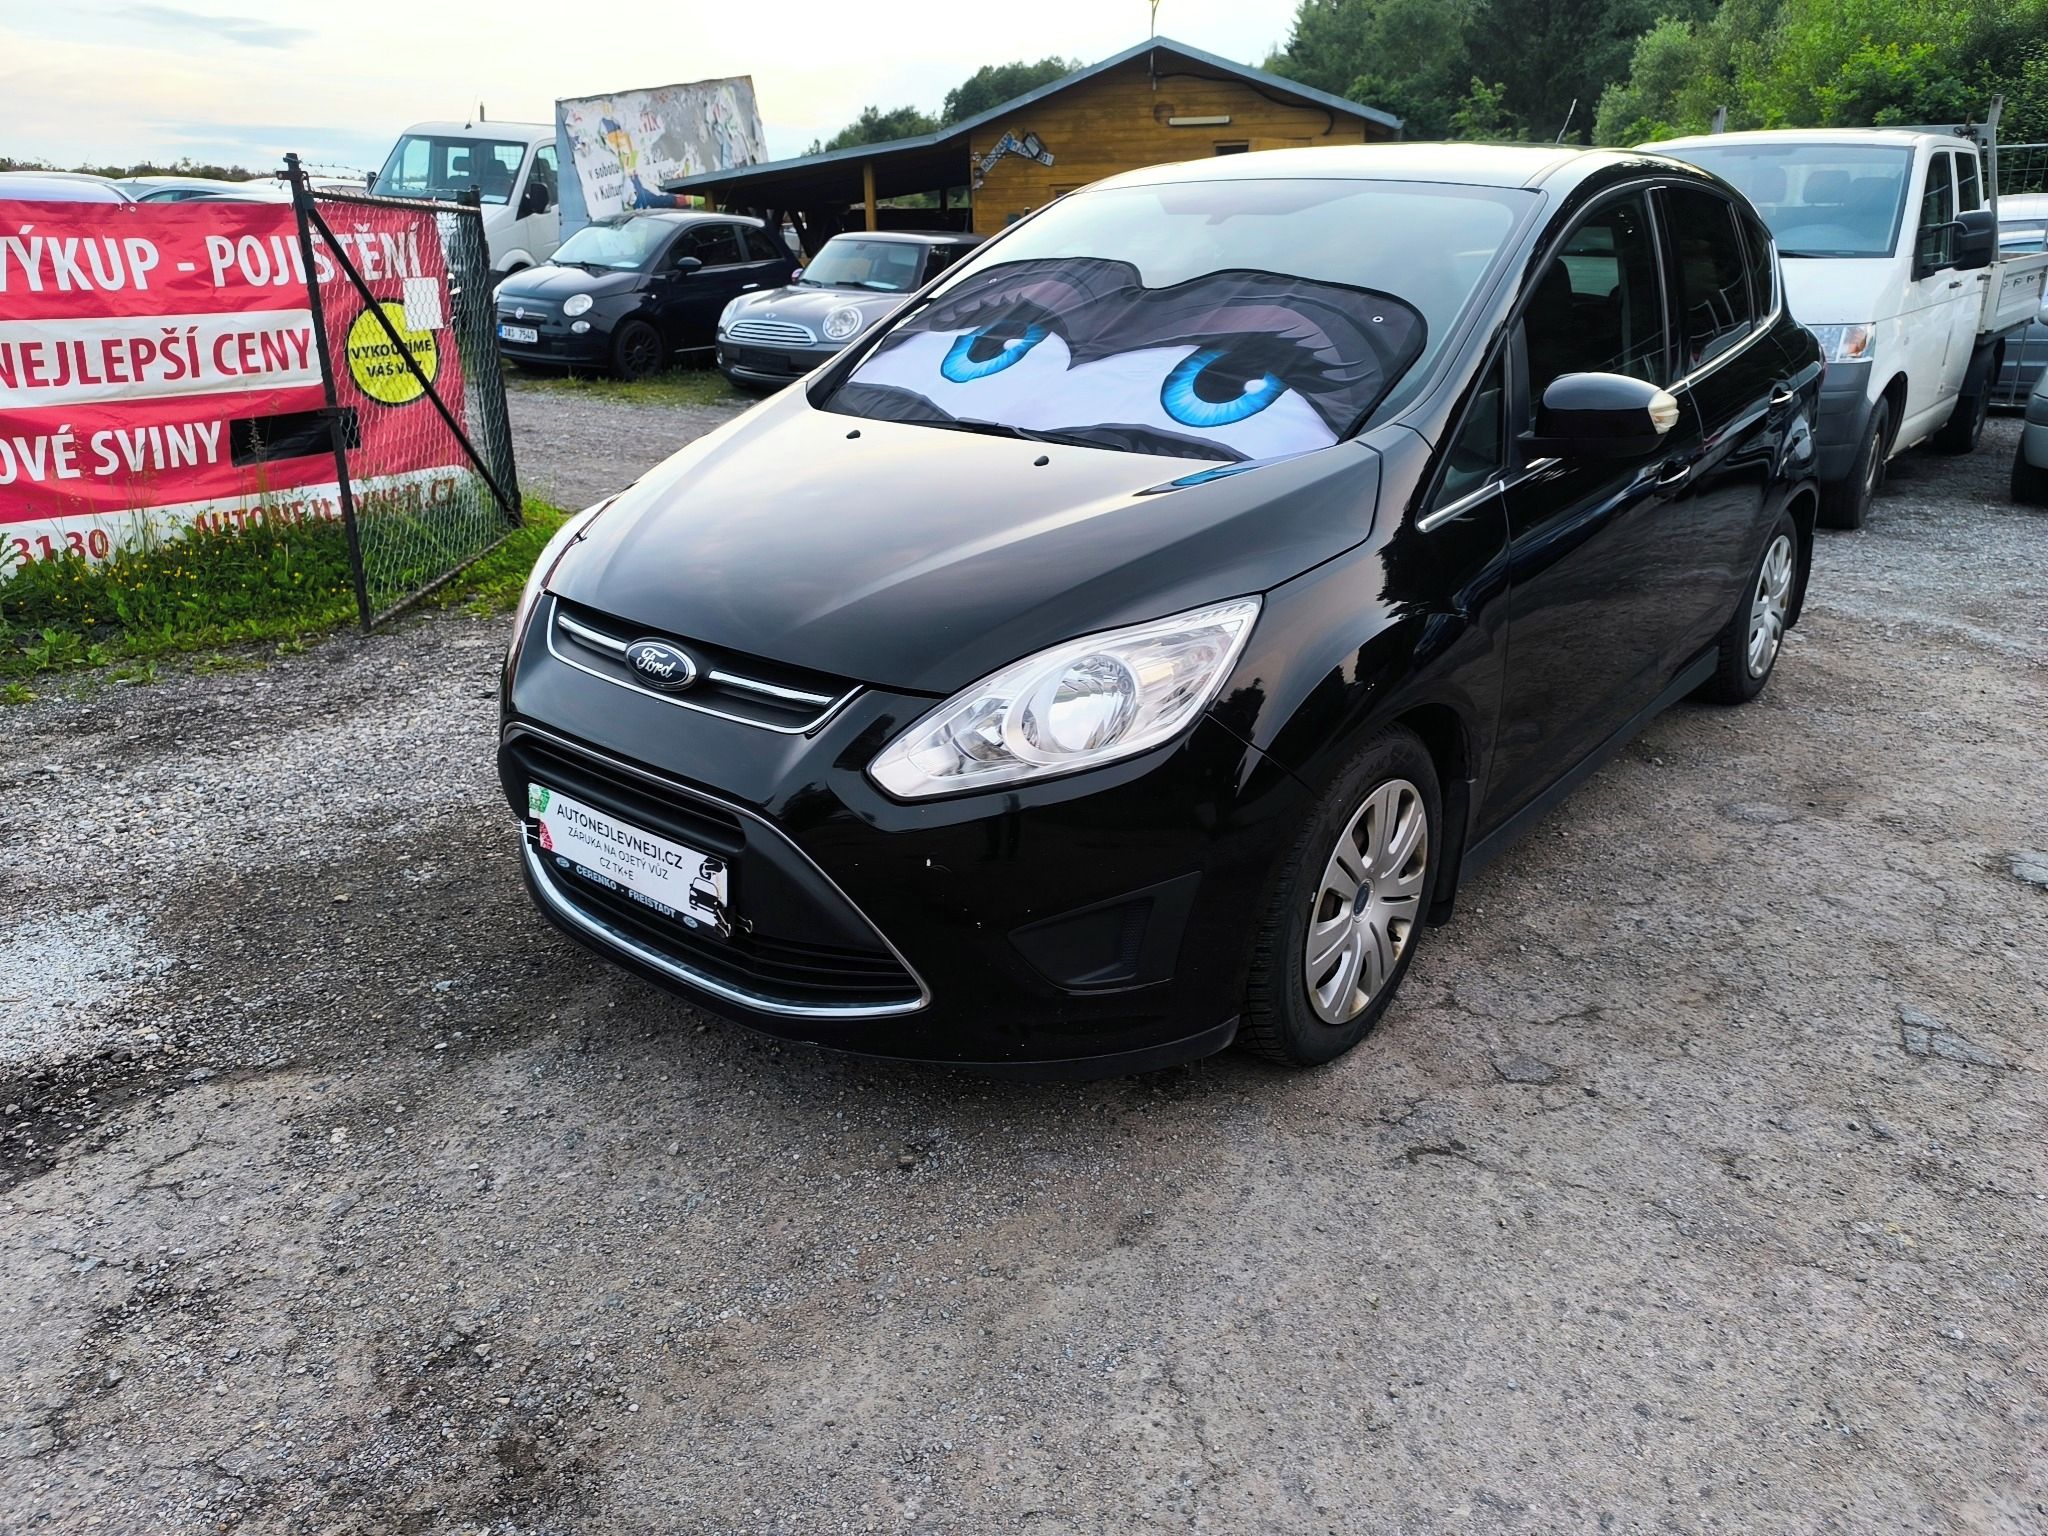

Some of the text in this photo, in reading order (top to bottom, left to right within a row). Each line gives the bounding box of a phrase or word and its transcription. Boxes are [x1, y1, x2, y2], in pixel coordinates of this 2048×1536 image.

[0, 224, 160, 292] ÝKUP
[206, 222, 422, 287] POJIŠTĚNÍ
[213, 328, 311, 376] CENY
[91, 421, 222, 476] SVINY
[636, 647, 677, 678] Ford
[557, 804, 683, 870] AUTONEJLEVNEJI.CZ
[568, 827, 601, 849] ZÁRUKA
[603, 843, 617, 857] NA
[618, 851, 648, 871] OJETÝ
[650, 862, 669, 880] VŮZ
[599, 857, 611, 870] CZ
